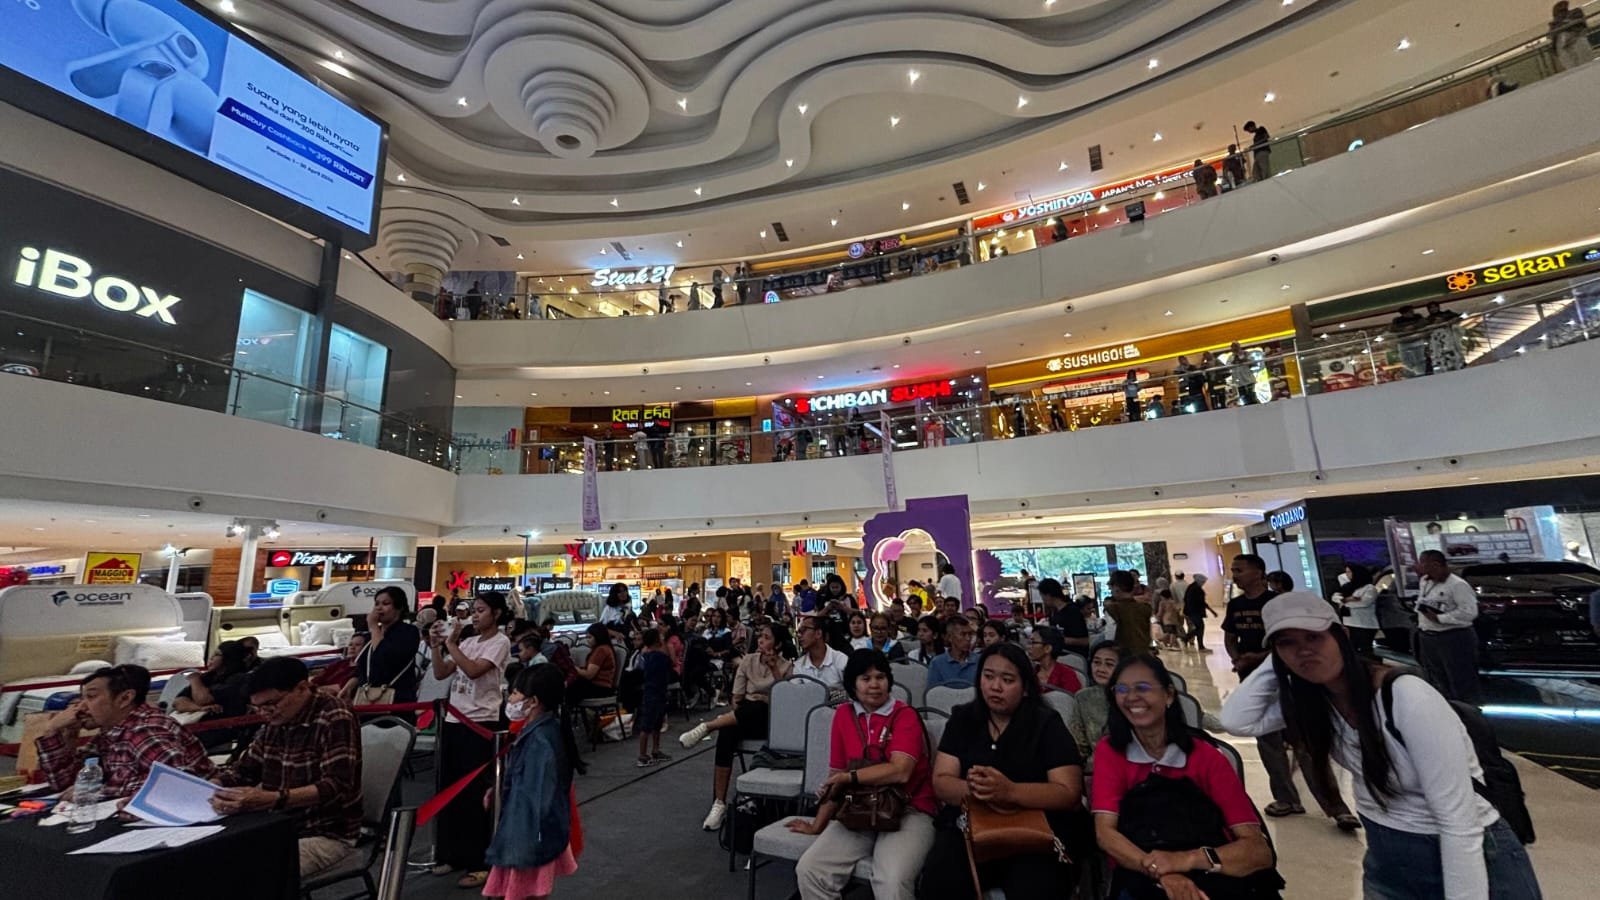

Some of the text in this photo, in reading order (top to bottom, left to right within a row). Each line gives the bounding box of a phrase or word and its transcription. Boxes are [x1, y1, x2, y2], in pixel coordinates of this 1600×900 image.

[230, 106, 267, 131] Multibuy
[246, 82, 361, 152] Suara yang lebih nyata
[1017, 191, 1095, 219] YOSHINOYA
[865, 238, 900, 253] RMEN
[591, 266, 649, 287] Steak
[1483, 251, 1571, 283] sekar
[15, 246, 182, 325] iBox
[810, 379, 952, 411] ICHIBAN SUSHI
[1270, 505, 1305, 531] GIORDANO
[589, 539, 648, 560] MAKO
[806, 537, 828, 556] MAKO
[290, 551, 327, 566] Pizza
[95, 569, 128, 577] MAGGIO
[74, 591, 131, 602] ocean
